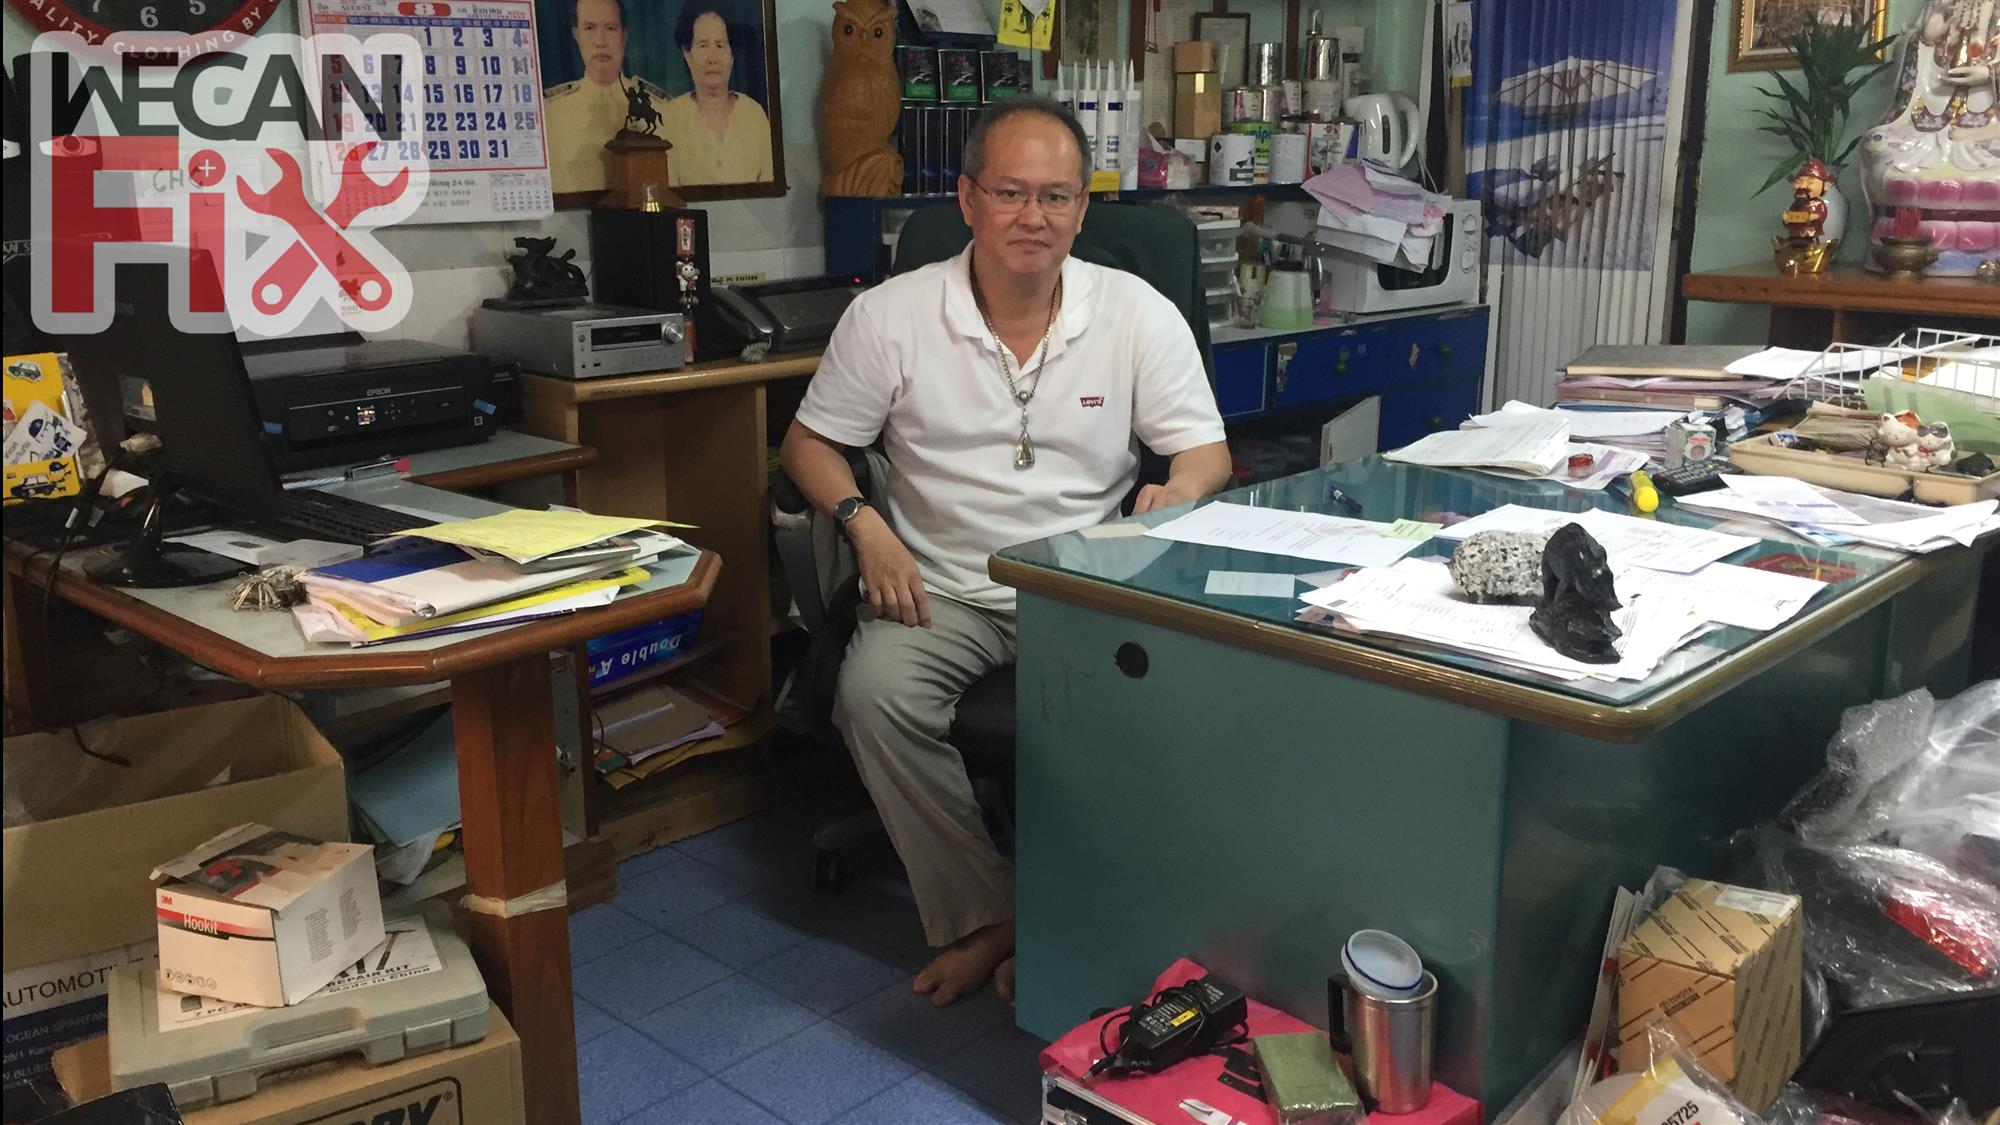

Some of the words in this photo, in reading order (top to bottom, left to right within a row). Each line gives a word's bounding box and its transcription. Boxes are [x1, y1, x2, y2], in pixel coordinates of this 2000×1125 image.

[140, 7, 159, 28] 6
[113, 30, 235, 60] CLOTHING
[241, 7, 261, 30] BY
[424, 27, 432, 46] 1
[453, 28, 464, 47] 2
[482, 28, 493, 47] 3
[513, 28, 522, 48] 4
[362, 54, 374, 74] 6
[394, 54, 403, 74] 7
[425, 55, 436, 75] 8
[455, 55, 466, 75] 9
[481, 56, 501, 75] 10
[361, 83, 383, 103] 13
[393, 83, 413, 103] 14
[424, 84, 444, 103] 15
[454, 84, 474, 103] 16
[483, 84, 502, 103] 17
[513, 84, 532, 103] 18
[333, 112, 354, 132] 19
[364, 112, 387, 132] 20
[396, 112, 416, 132] 21
[425, 112, 448, 131] 22
[455, 112, 477, 131] 23
[485, 112, 507, 130] 24
[513, 111, 536, 130] 25
[366, 141, 389, 161] 27
[398, 141, 420, 160] 28
[428, 140, 451, 160] 29
[458, 140, 480, 159] 30
[488, 139, 509, 158] 31
[366, 387, 391, 397] EPSON
[621, 634, 682, 666] Double
[595, 658, 613, 679] A
[161, 895, 172, 905] 3M
[183, 913, 218, 935] Hookit
[385, 964, 410, 974] KIT
[329, 982, 368, 993] Made
[6, 1025, 49, 1044] OCEAN
